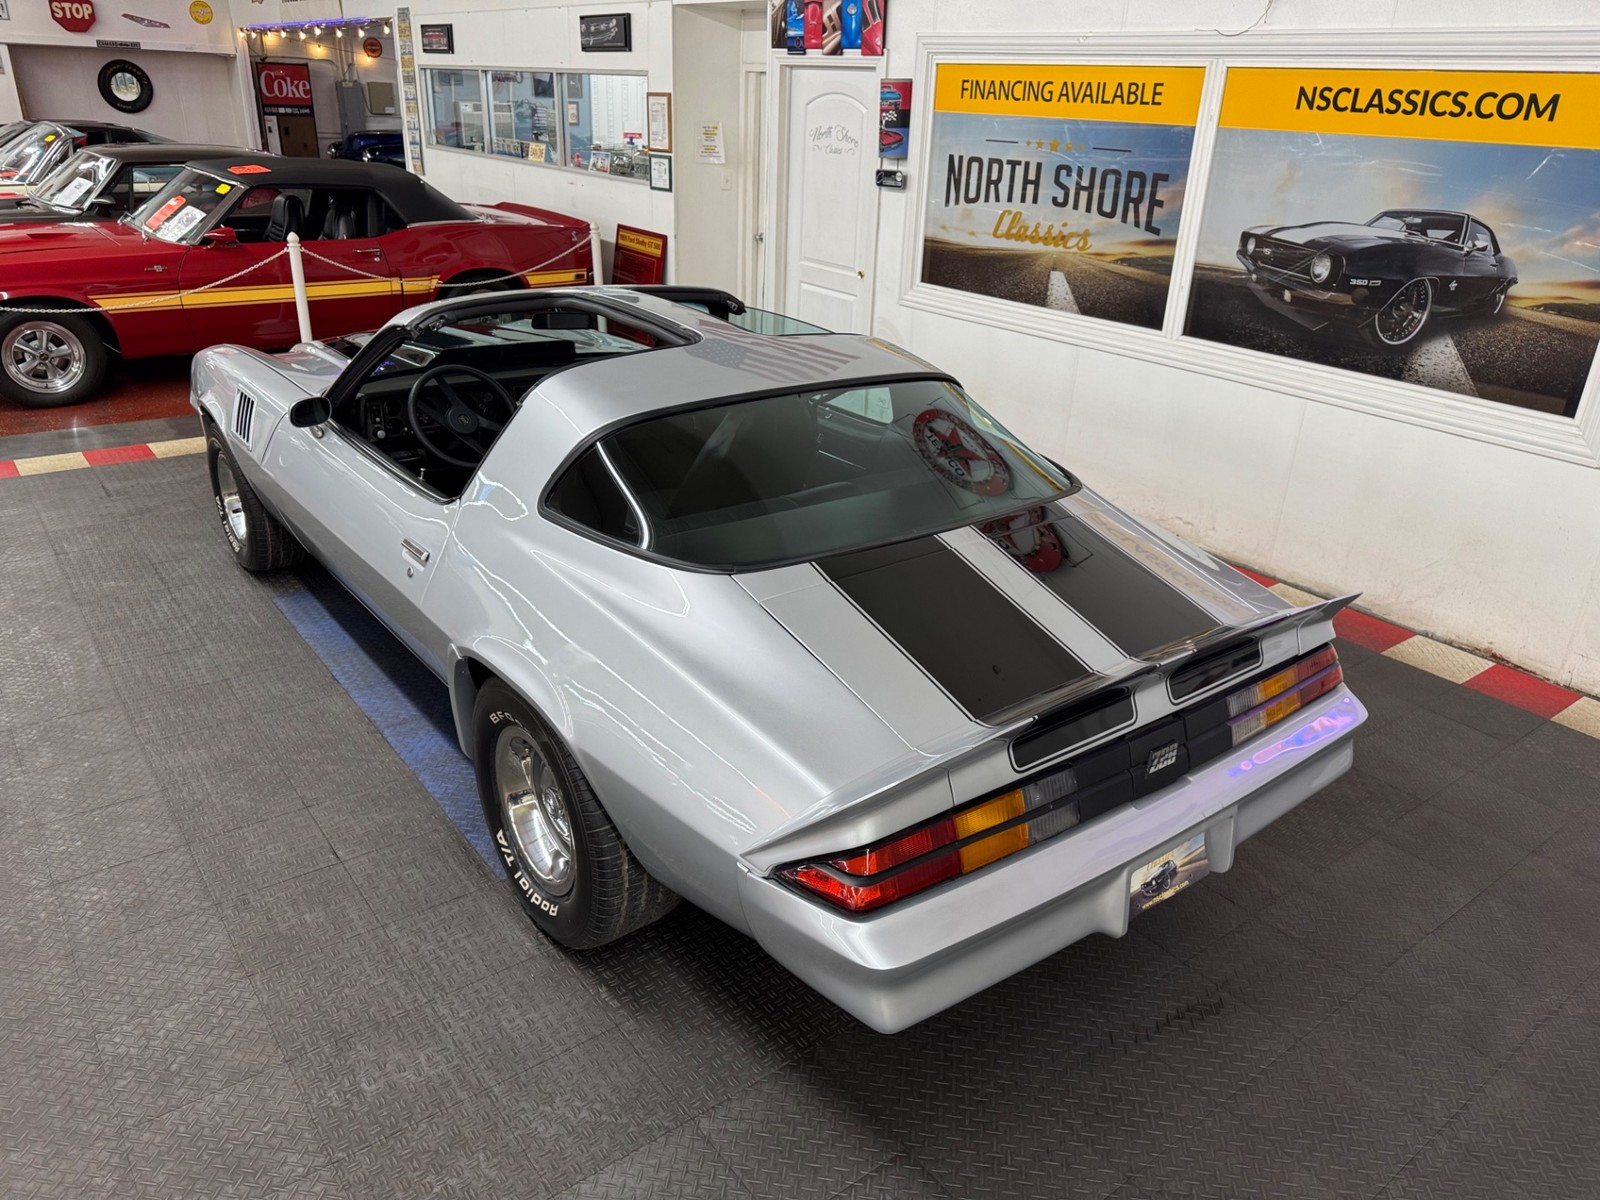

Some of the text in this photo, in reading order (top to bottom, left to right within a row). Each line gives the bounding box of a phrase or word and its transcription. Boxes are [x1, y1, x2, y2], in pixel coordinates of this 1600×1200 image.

[51, 1, 92, 20] STOP
[260, 70, 311, 99] Coke
[960, 79, 1165, 106] FINANCING AVAILABLE
[1294, 86, 1561, 122] NSCLASSICS.COM
[944, 153, 1170, 237] NORTH SHORE
[992, 208, 1093, 252] Classics
[1349, 278, 1369, 286] 350
[496, 829, 560, 917] Radial T/A
